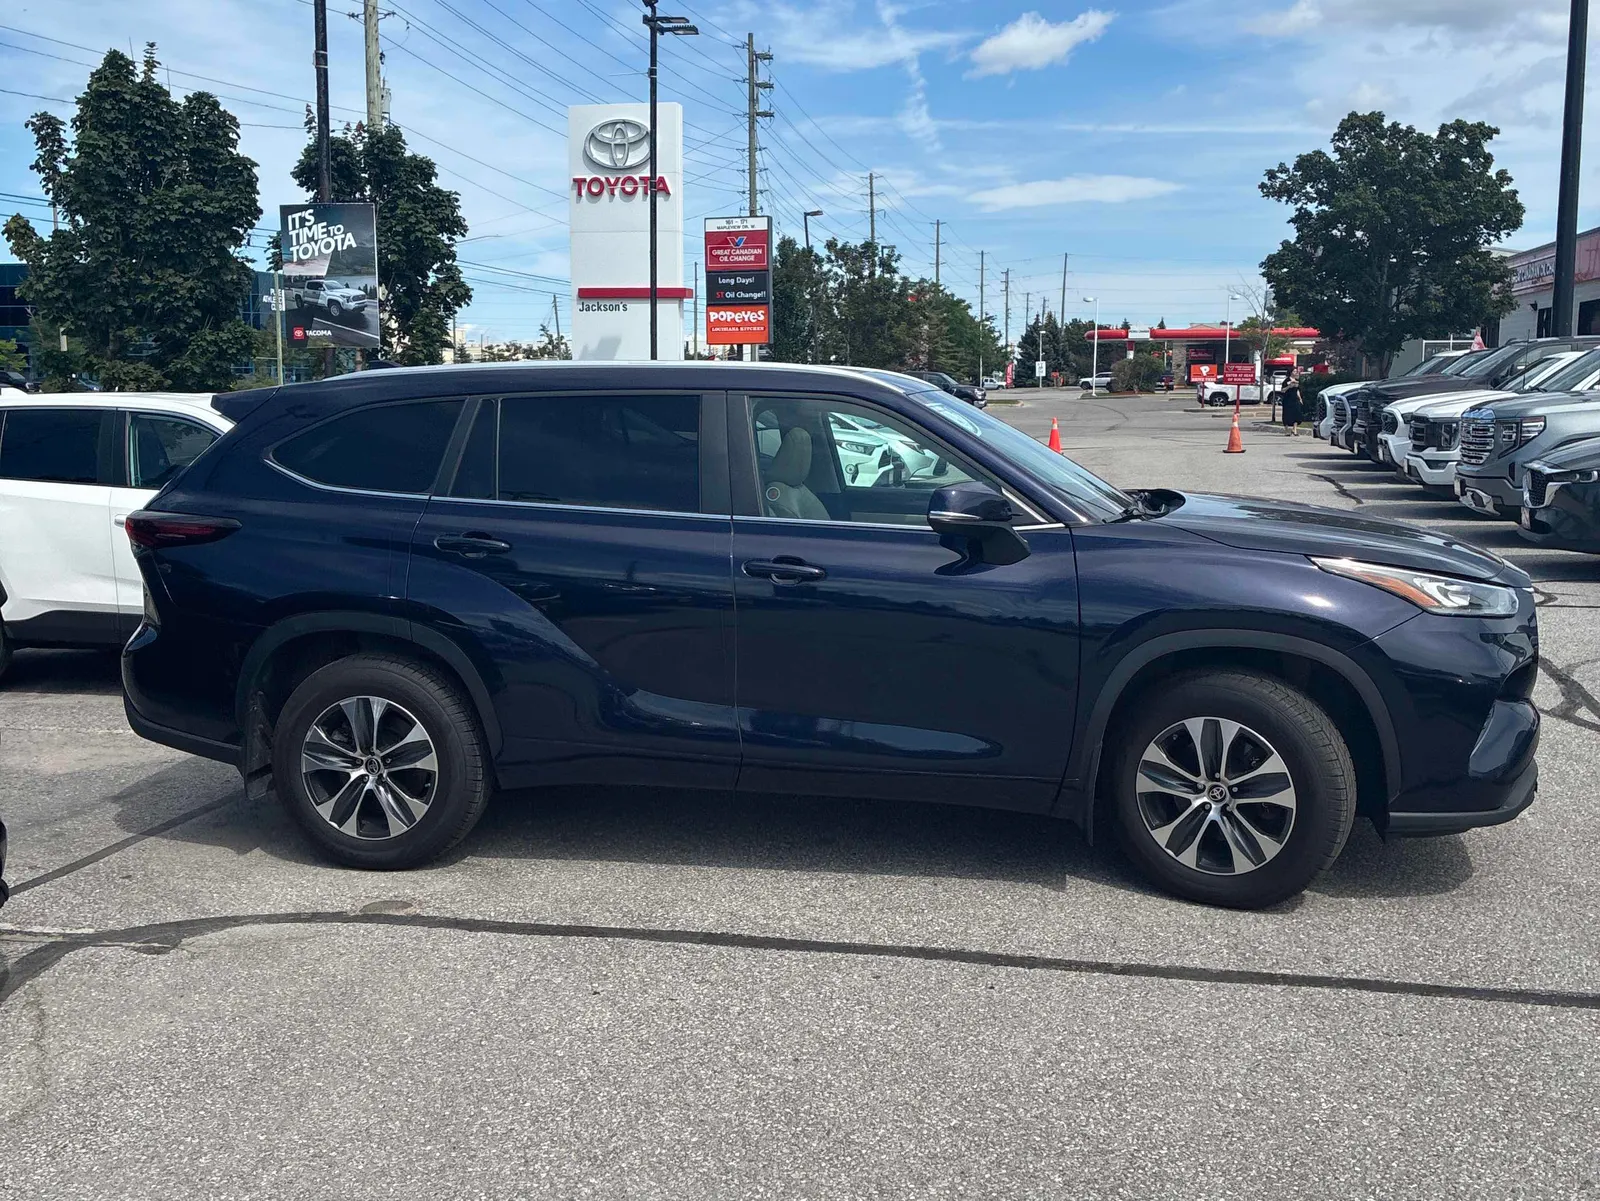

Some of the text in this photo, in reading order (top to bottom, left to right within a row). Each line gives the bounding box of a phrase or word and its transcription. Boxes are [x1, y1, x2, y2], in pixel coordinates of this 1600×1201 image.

[573, 175, 671, 197] TOYOTA
[287, 208, 315, 231] IT'S
[288, 221, 344, 247] TIME TO
[289, 232, 357, 263] TOYOTA
[718, 276, 755, 286] Long Days!
[736, 290, 766, 300] Change!!
[578, 301, 628, 313] Jackson's
[305, 329, 333, 337] TACOMA
